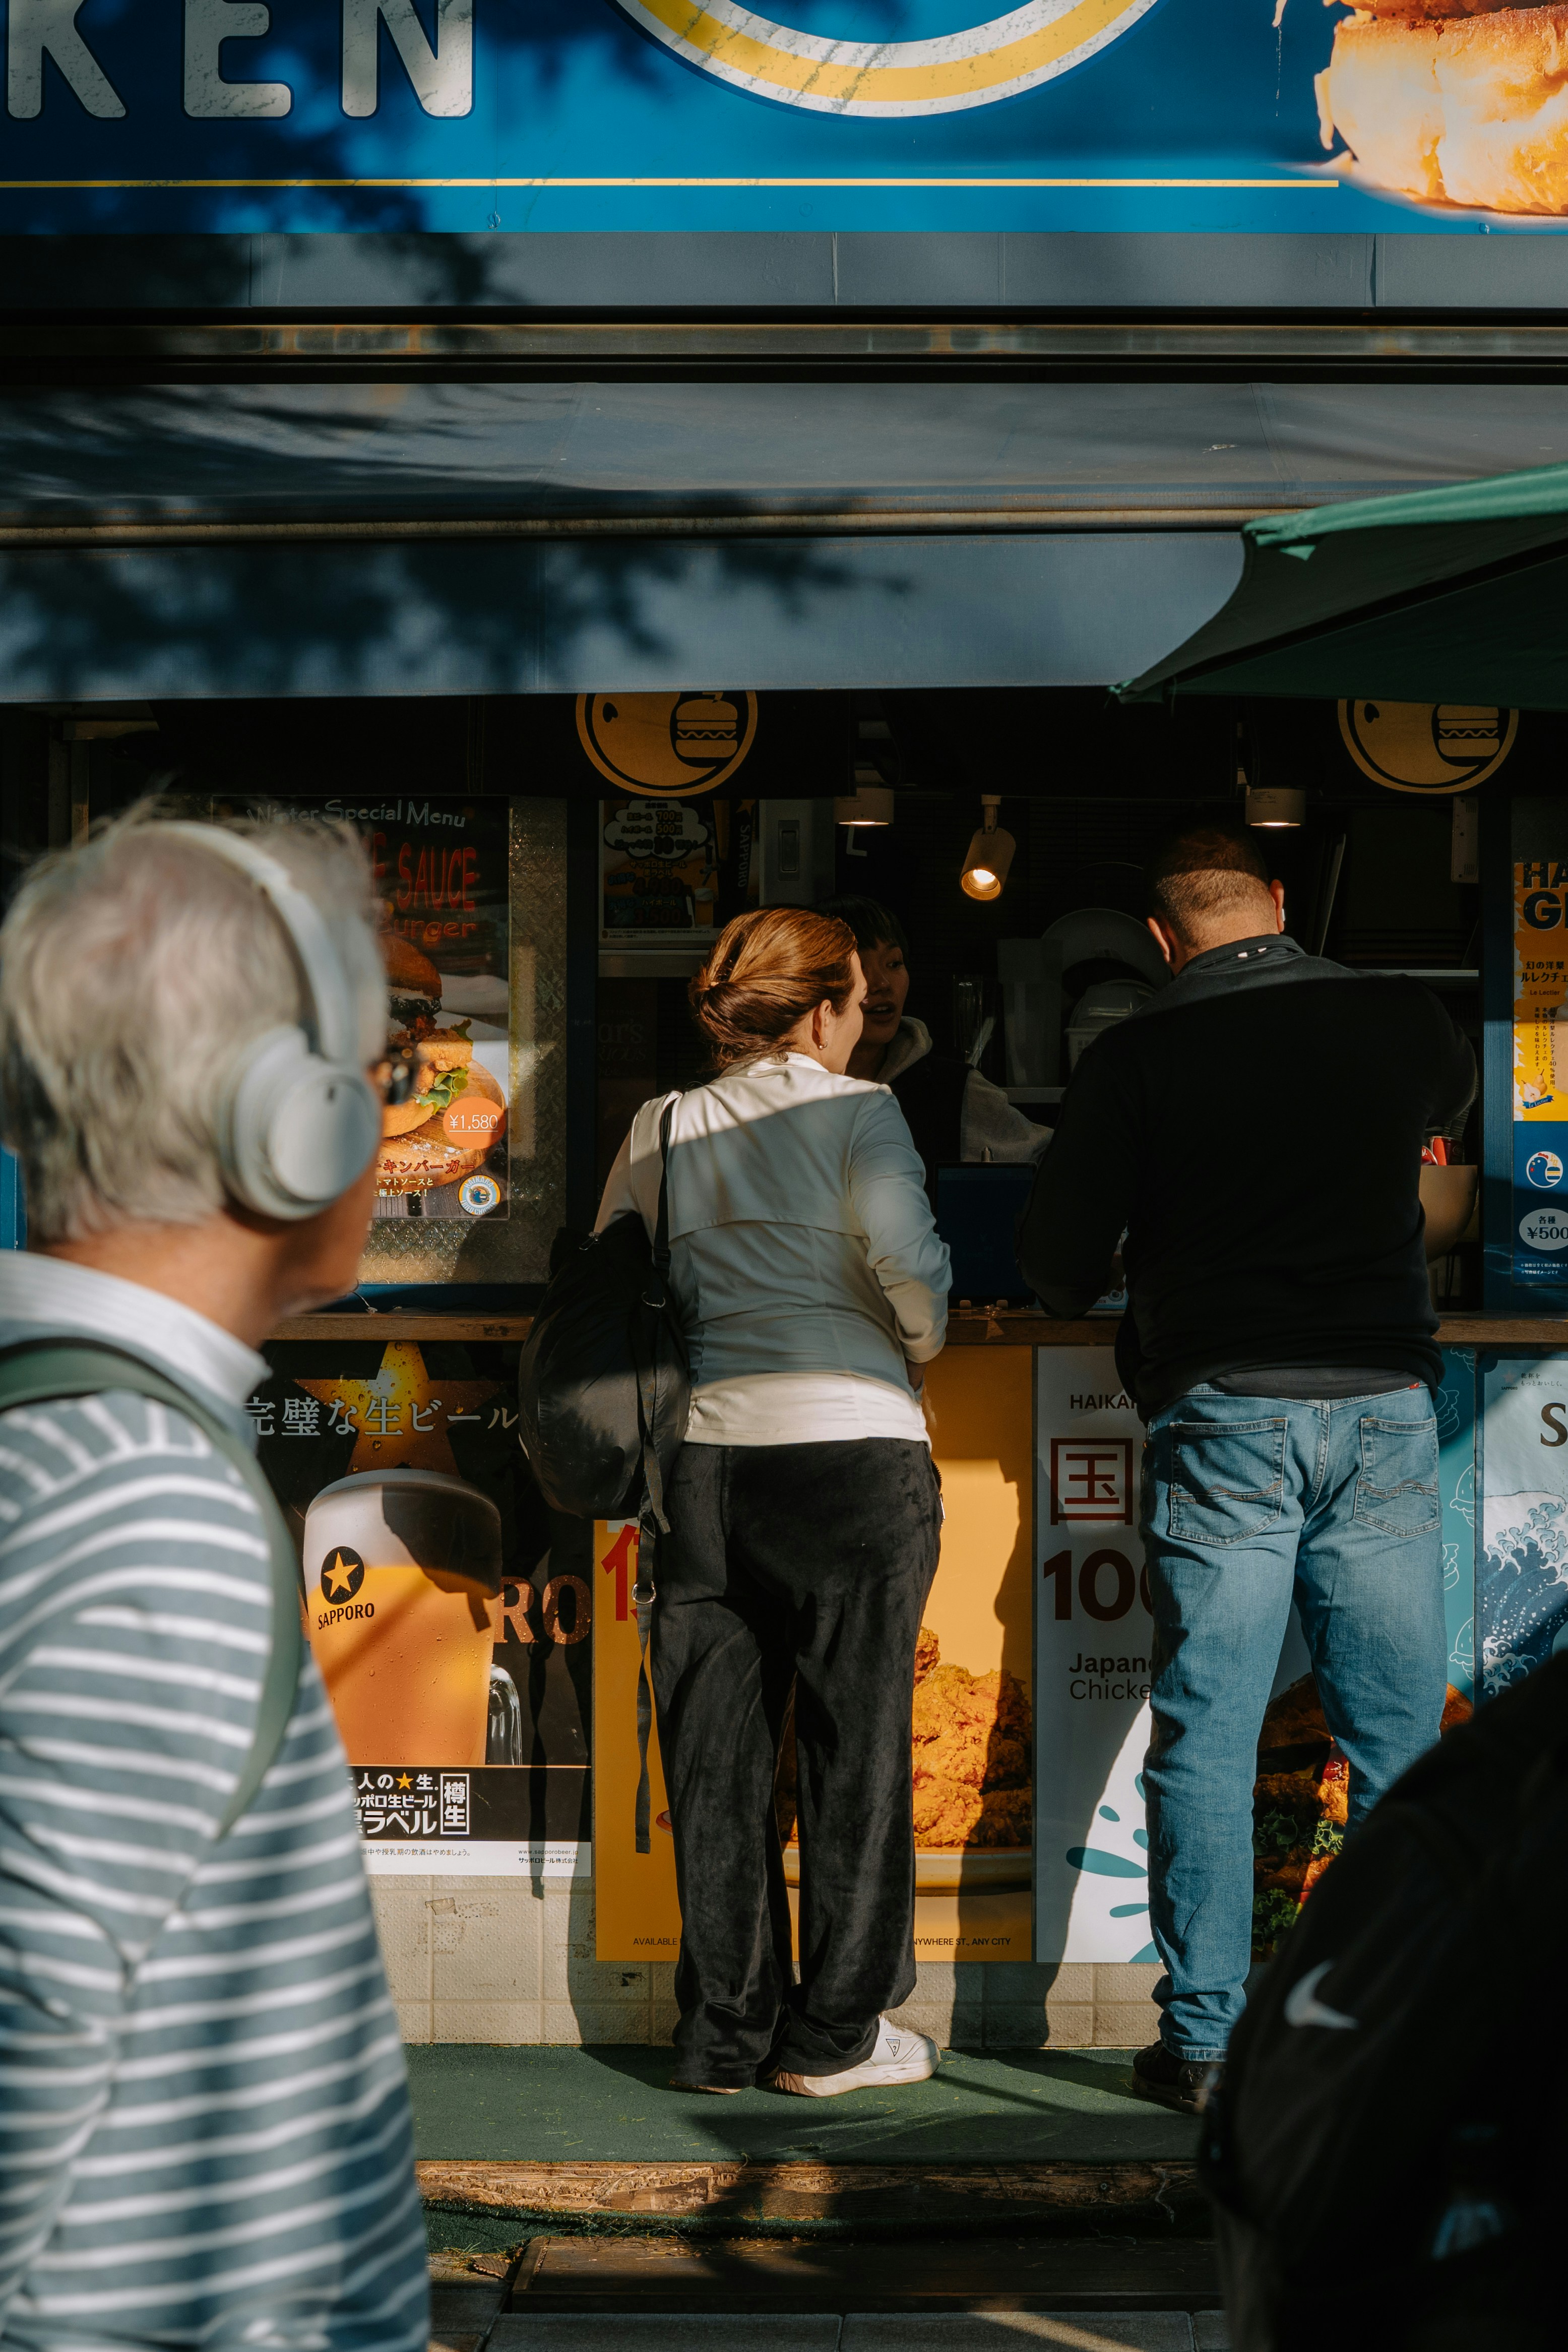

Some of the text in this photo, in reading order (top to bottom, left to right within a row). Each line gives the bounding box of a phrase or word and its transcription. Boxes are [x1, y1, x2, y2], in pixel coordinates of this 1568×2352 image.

[8, 0, 472, 118] KEN
[322, 799, 402, 825] Special
[406, 800, 465, 828] Menu
[738, 824, 751, 888] SAPPORO
[397, 842, 477, 912] SAUCE
[1524, 891, 1568, 930] G
[1526, 961, 1564, 970] 幻の洋梨
[450, 1115, 498, 1130] ¥1,580
[464, 1176, 494, 1188] HAIKARA
[460, 1200, 474, 1213] FRIED
[1539, 1216, 1556, 1224] 各種
[1043, 1549, 1153, 1622] 10
[318, 1603, 374, 1630] SAPPORO
[1069, 1653, 1152, 1681] Japan
[444, 1782, 466, 1827] 樽生
